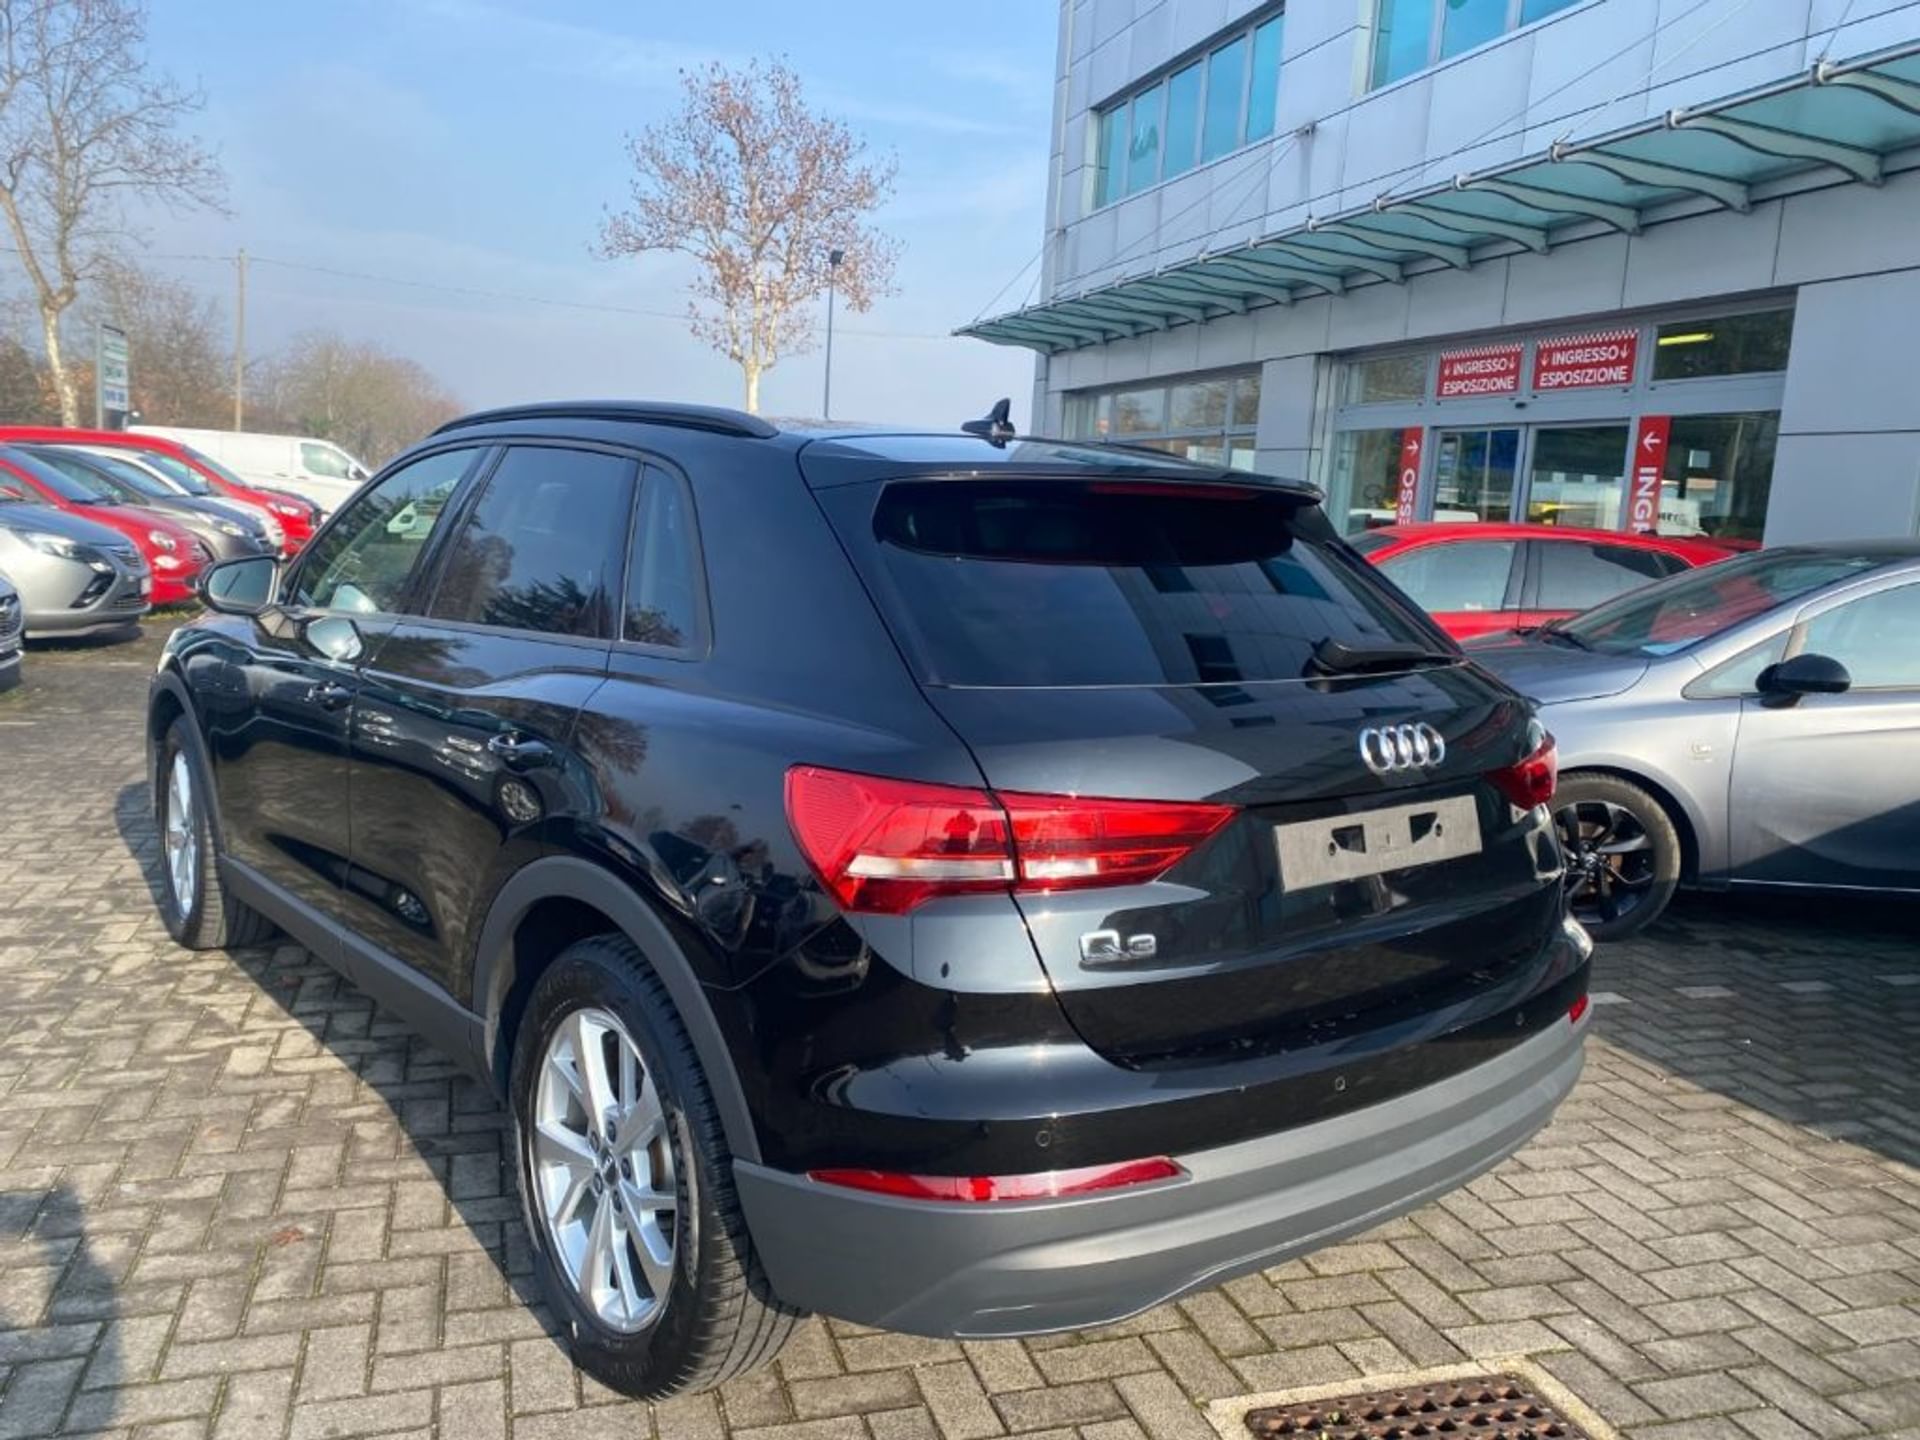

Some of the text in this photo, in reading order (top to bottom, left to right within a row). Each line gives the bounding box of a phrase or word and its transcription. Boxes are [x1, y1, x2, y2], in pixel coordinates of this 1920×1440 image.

[1552, 345, 1620, 367] INGRESSO
[1453, 358, 1508, 376] INGRESSO
[1540, 366, 1629, 387] ESPOSIZIONE
[1442, 375, 1517, 395] ESPOSIZIONE
[1080, 929, 1156, 964] Q3
